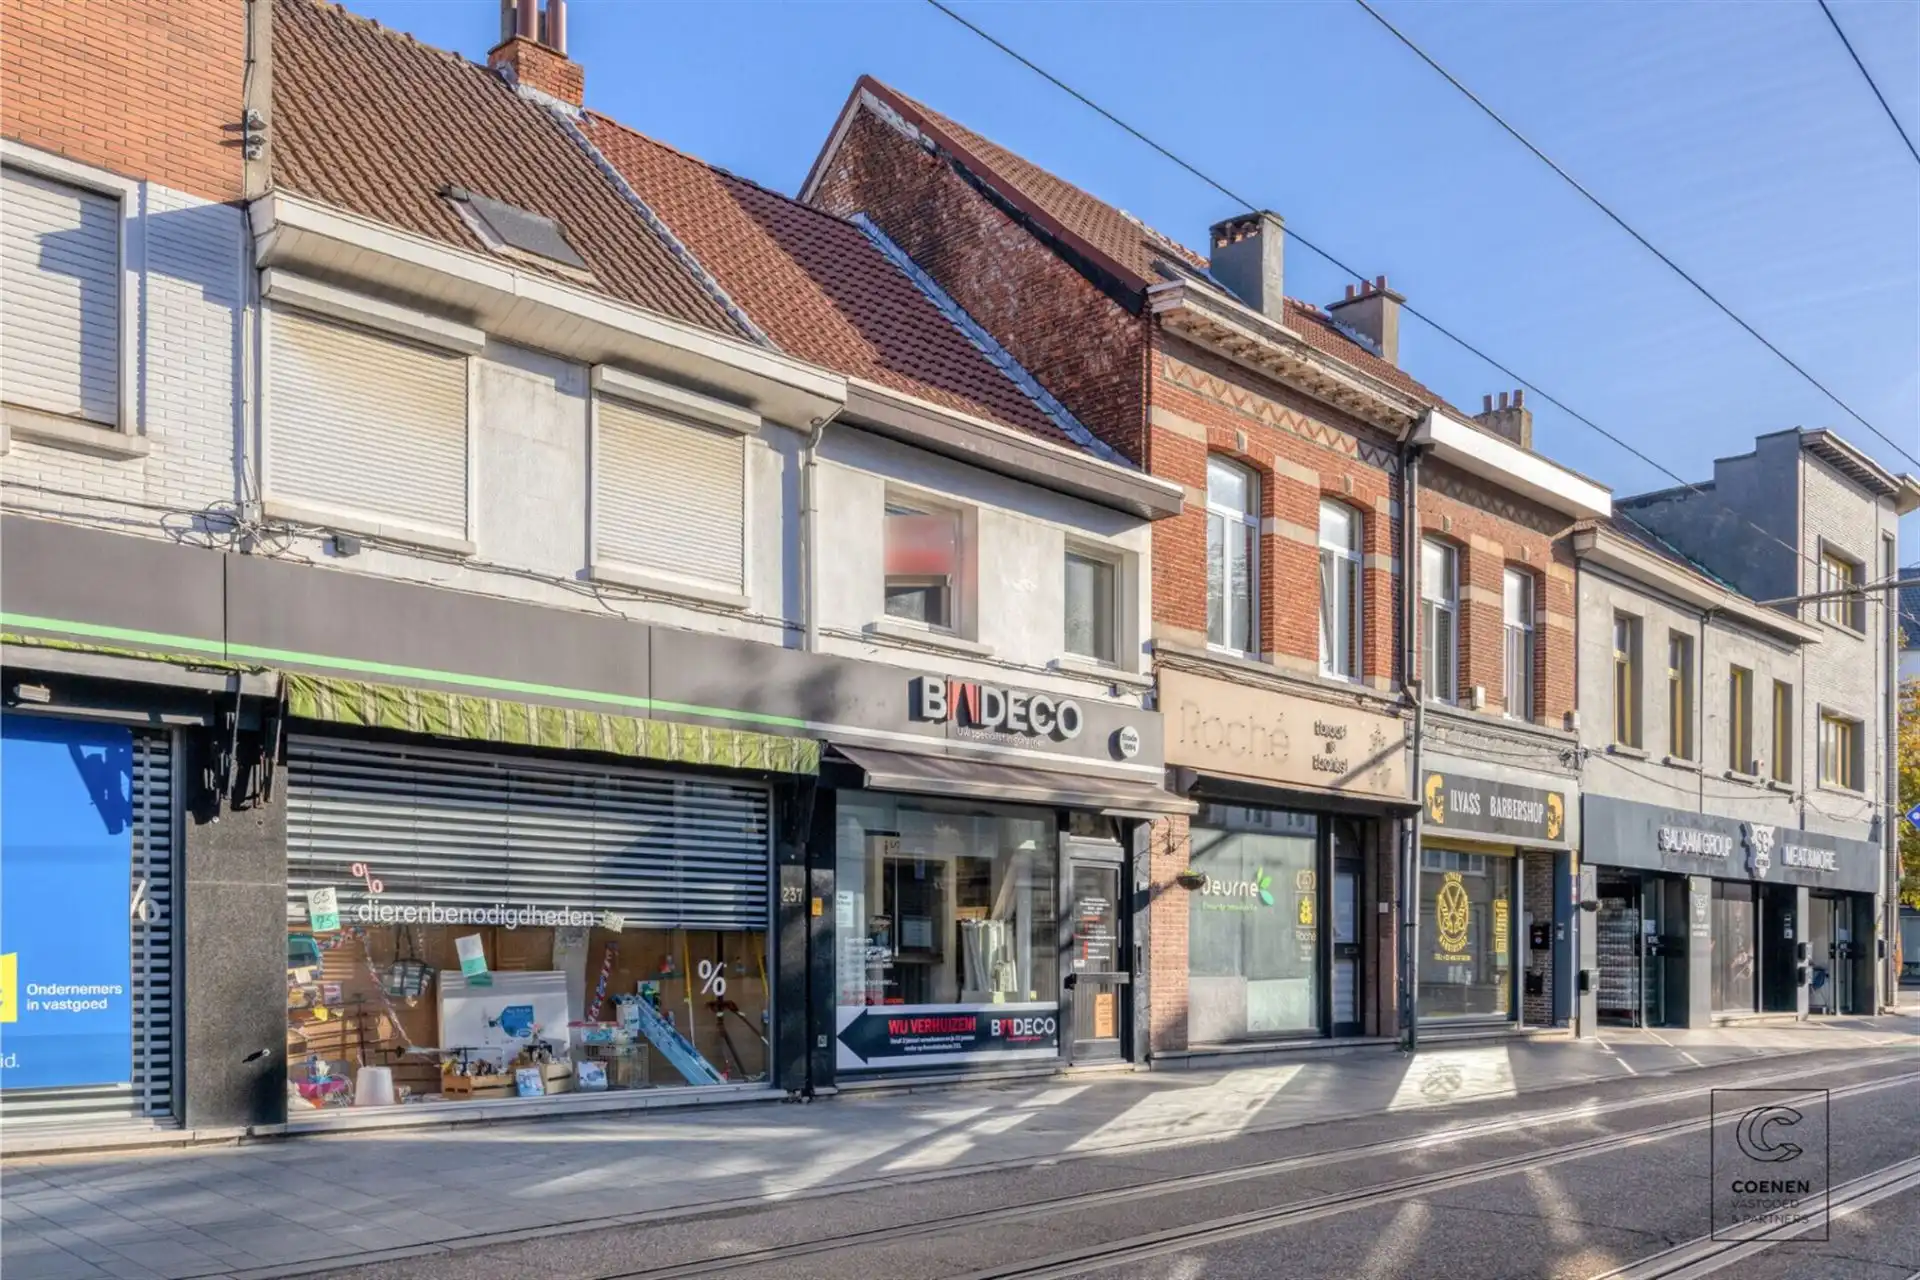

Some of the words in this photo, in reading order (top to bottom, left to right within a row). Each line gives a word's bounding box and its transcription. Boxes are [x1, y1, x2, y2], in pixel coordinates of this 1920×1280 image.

[1450, 788, 1481, 816] ILYASS
[1489, 799, 1545, 825] BARBERSHOP
[783, 886, 803, 903] 237
[358, 899, 595, 930] dierenbenodigdheden
[26, 983, 123, 996] Ondernemers
[26, 998, 40, 1011] in
[42, 997, 108, 1012] vastgoed
[910, 1015, 976, 1034] VERHUIZEN!
